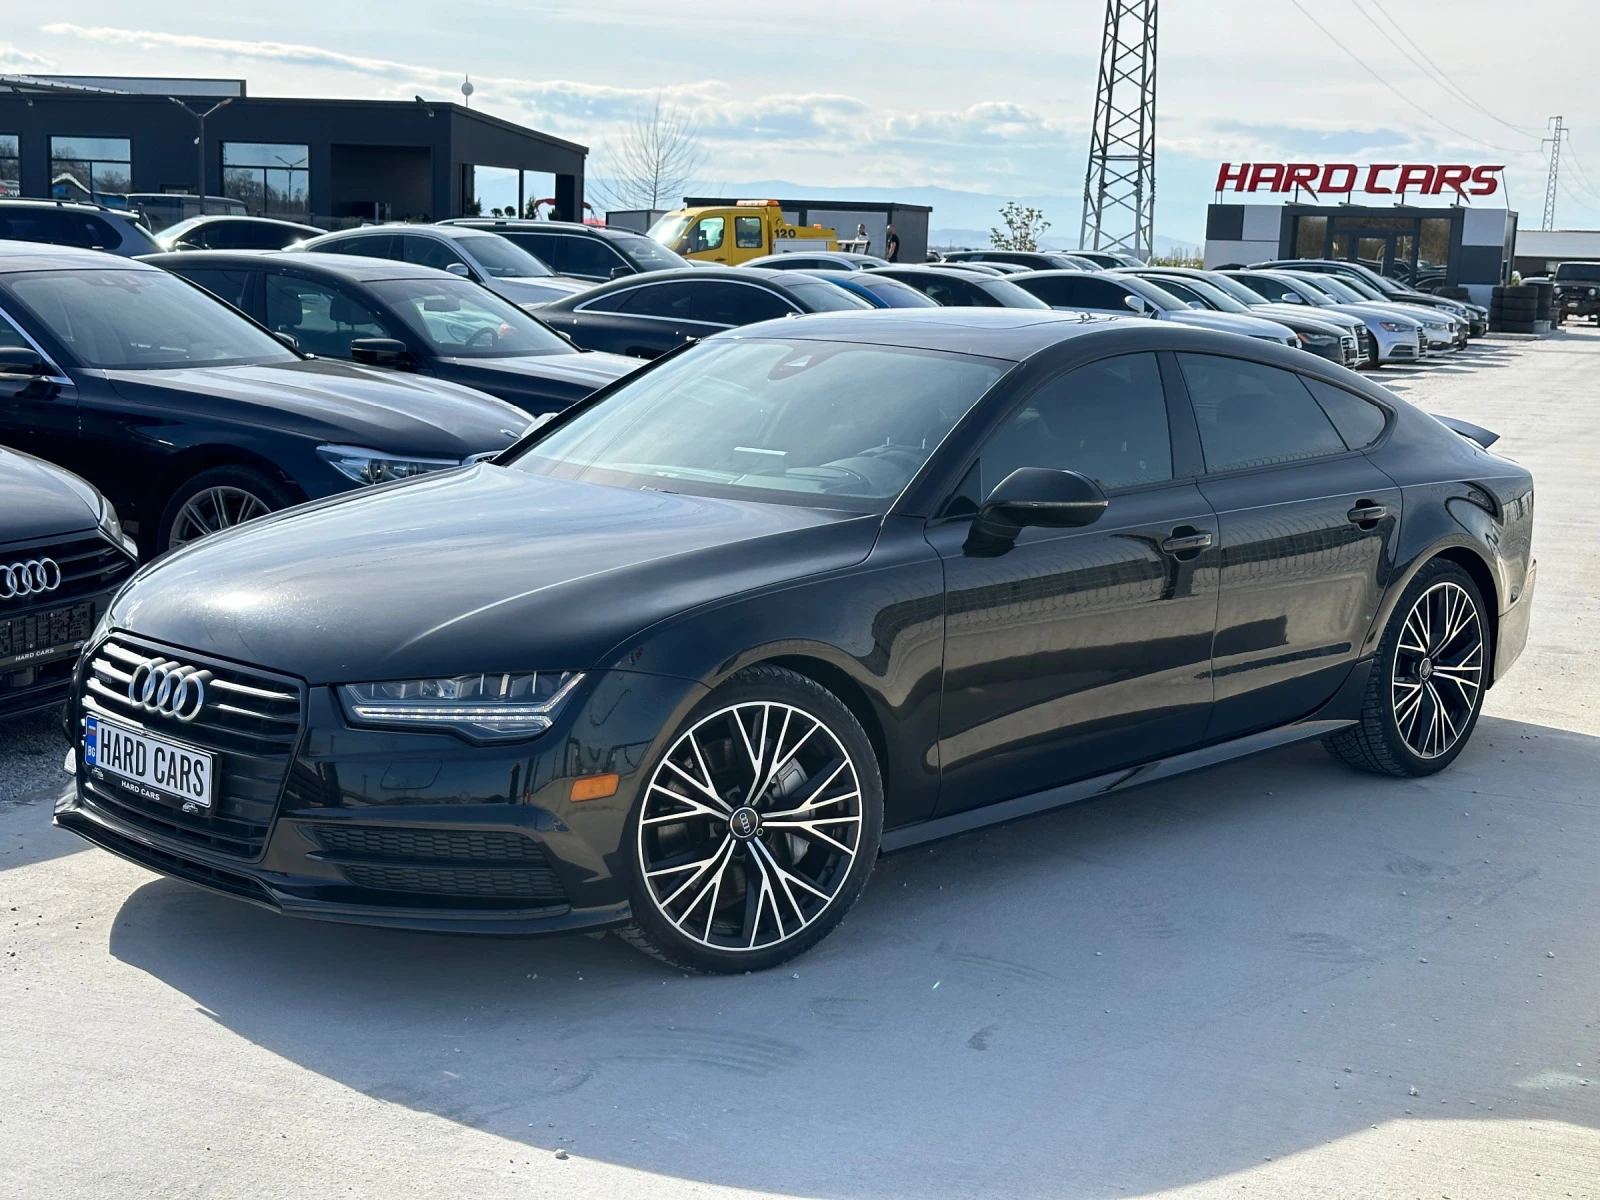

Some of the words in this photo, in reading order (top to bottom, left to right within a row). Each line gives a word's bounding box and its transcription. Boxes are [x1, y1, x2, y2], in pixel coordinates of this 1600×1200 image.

[1215, 163, 1358, 202] HARD
[1364, 164, 1506, 205] CARS
[774, 229, 796, 239] 120
[15, 652, 34, 661] HARD
[35, 648, 55, 656] CARS
[87, 745, 96, 758] BG
[100, 727, 147, 777] HARD
[153, 746, 205, 797] CARS
[121, 780, 140, 793] HARD
[140, 788, 161, 801] CARS
